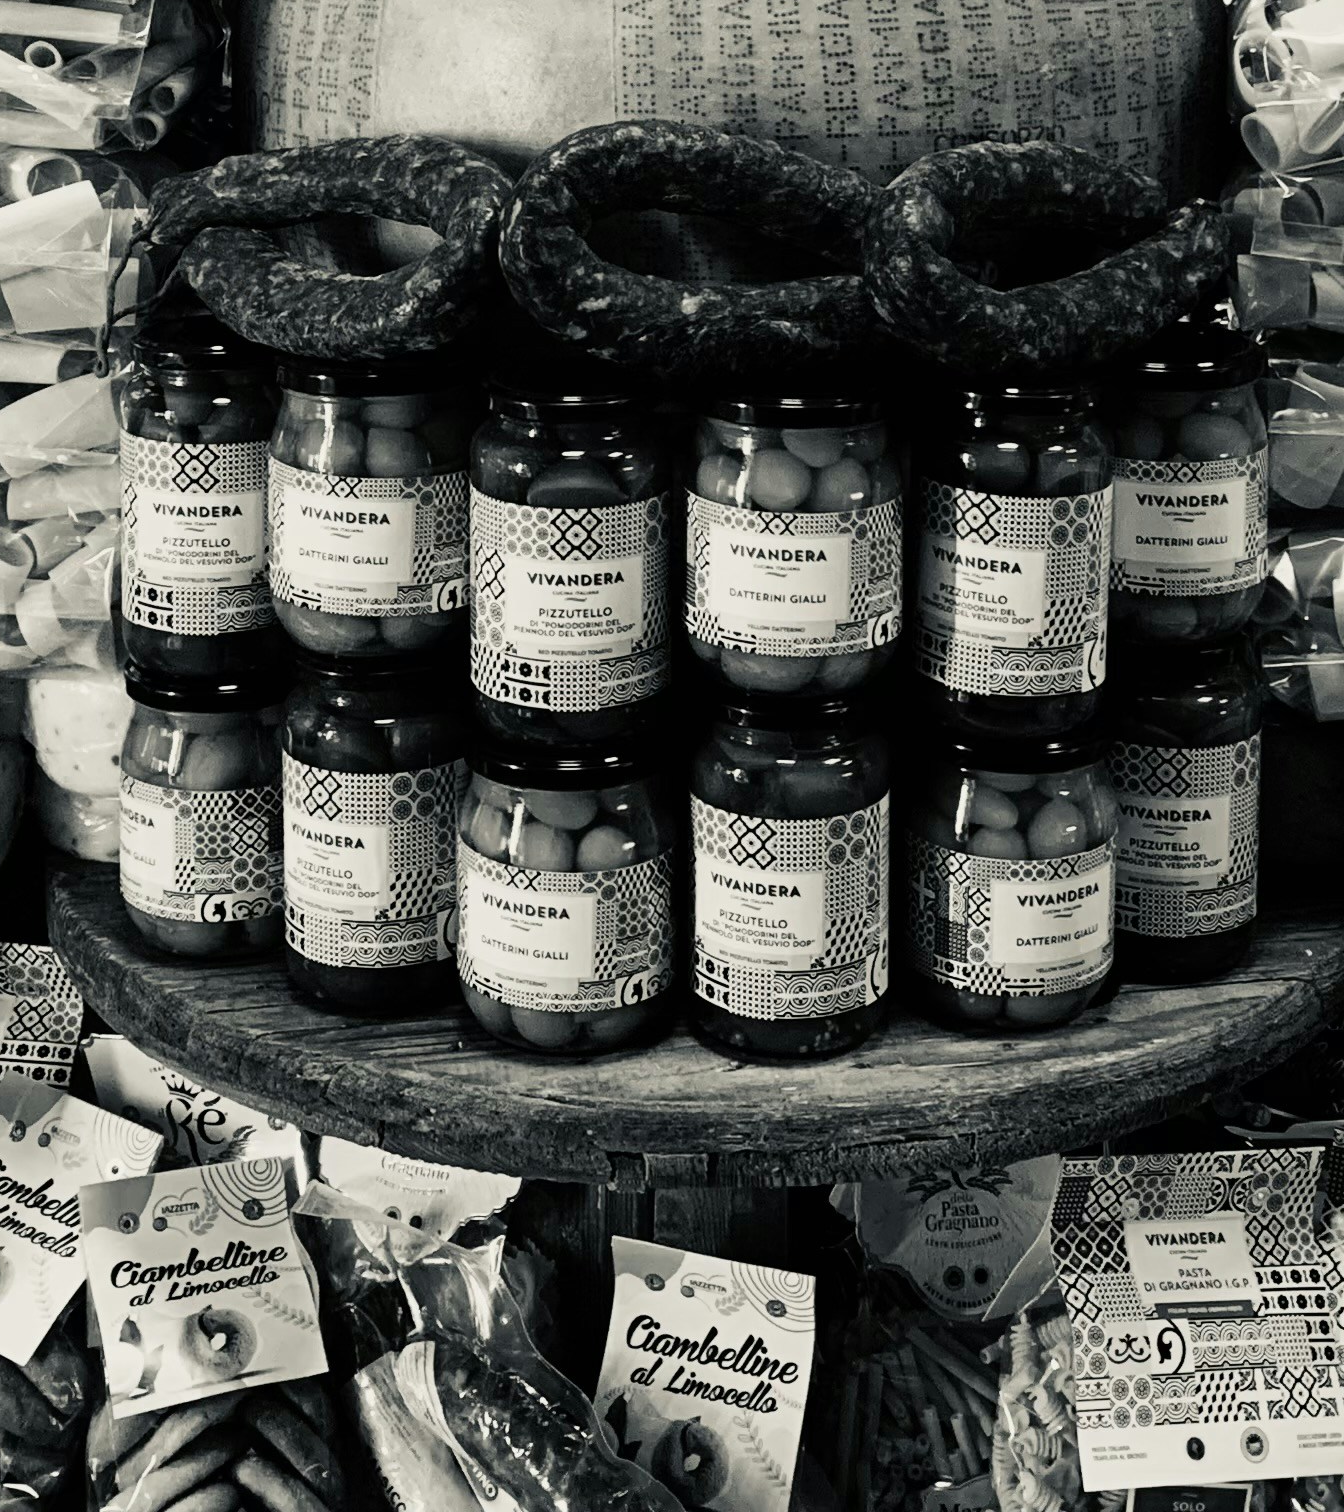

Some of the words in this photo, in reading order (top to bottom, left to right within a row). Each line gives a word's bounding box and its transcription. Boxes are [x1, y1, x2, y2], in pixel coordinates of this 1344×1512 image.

[1135, 492, 1230, 508] VIVANDERA
[152, 502, 243, 519] VIVANDERA
[299, 503, 392, 526] VIVANDERA
[162, 536, 231, 549] PIZZUTELLO
[1135, 534, 1194, 548] DATTERINI
[1196, 534, 1229, 547] GIALLI
[299, 546, 351, 565] DATTERINI
[352, 554, 390, 566] GIALLI
[729, 543, 828, 563] VIVANDERA
[932, 544, 1023, 576] VIVANDERA
[526, 571, 625, 588] VIVANDERA
[728, 587, 786, 605] DATTERINI
[789, 593, 827, 605] GIALLI
[939, 582, 1008, 606] PIZZUTELLO
[538, 606, 613, 619] PIZZUTELLO
[558, 630, 575, 638] DEL
[577, 627, 614, 637] VESUVIO
[607, 619, 621, 627] DEL
[1118, 803, 1212, 822] VIVANDERA
[291, 821, 366, 850] VIVANDERA
[1129, 837, 1201, 852] PIZZUTELLO
[296, 855, 353, 880] PIZZUTELLO
[710, 870, 801, 899] VIVANDERA
[1016, 882, 1100, 908] VIVANDERA
[481, 891, 570, 921] VIVANDERA
[719, 908, 789, 930] PIZZUTELLO
[1016, 932, 1073, 948] DATTERINI
[1074, 923, 1099, 940] GIALLI
[481, 934, 530, 959] DATTERINI
[532, 949, 569, 963] GIALLI
[939, 1199, 984, 1219] Pasta
[924, 1210, 1001, 1235] Gragnano
[1144, 1231, 1227, 1247] VIVANDERA
[109, 1239, 289, 1289] Ciambelline
[1178, 1267, 1213, 1279] PASTA
[128, 1284, 156, 1308] al
[164, 1265, 282, 1303] Limocello
[1143, 1281, 1157, 1293] DI
[1158, 1278, 1223, 1292] GRAGNANO
[626, 1314, 799, 1385] Ciambelline
[629, 1356, 663, 1387] al
[662, 1365, 779, 1414] Limocello
